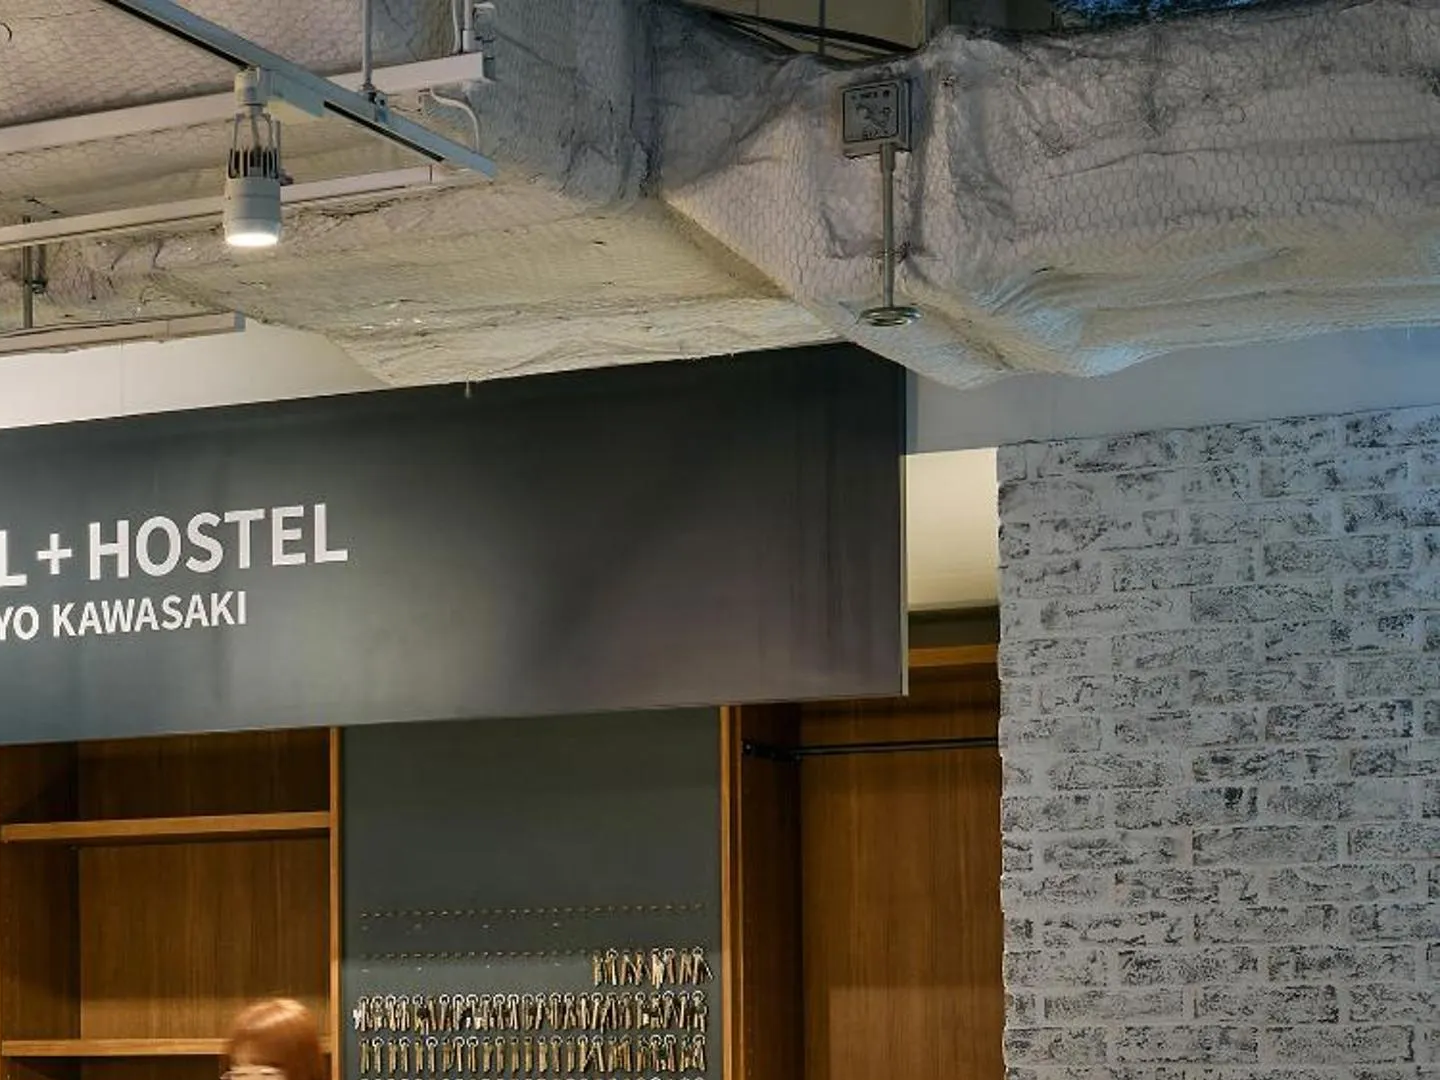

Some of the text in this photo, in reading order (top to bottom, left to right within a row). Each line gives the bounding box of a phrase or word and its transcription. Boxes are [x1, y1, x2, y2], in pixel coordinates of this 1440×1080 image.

[36, 533, 72, 575] +
[89, 503, 348, 580] HOSTEL
[52, 590, 247, 637] KAWASAKI
